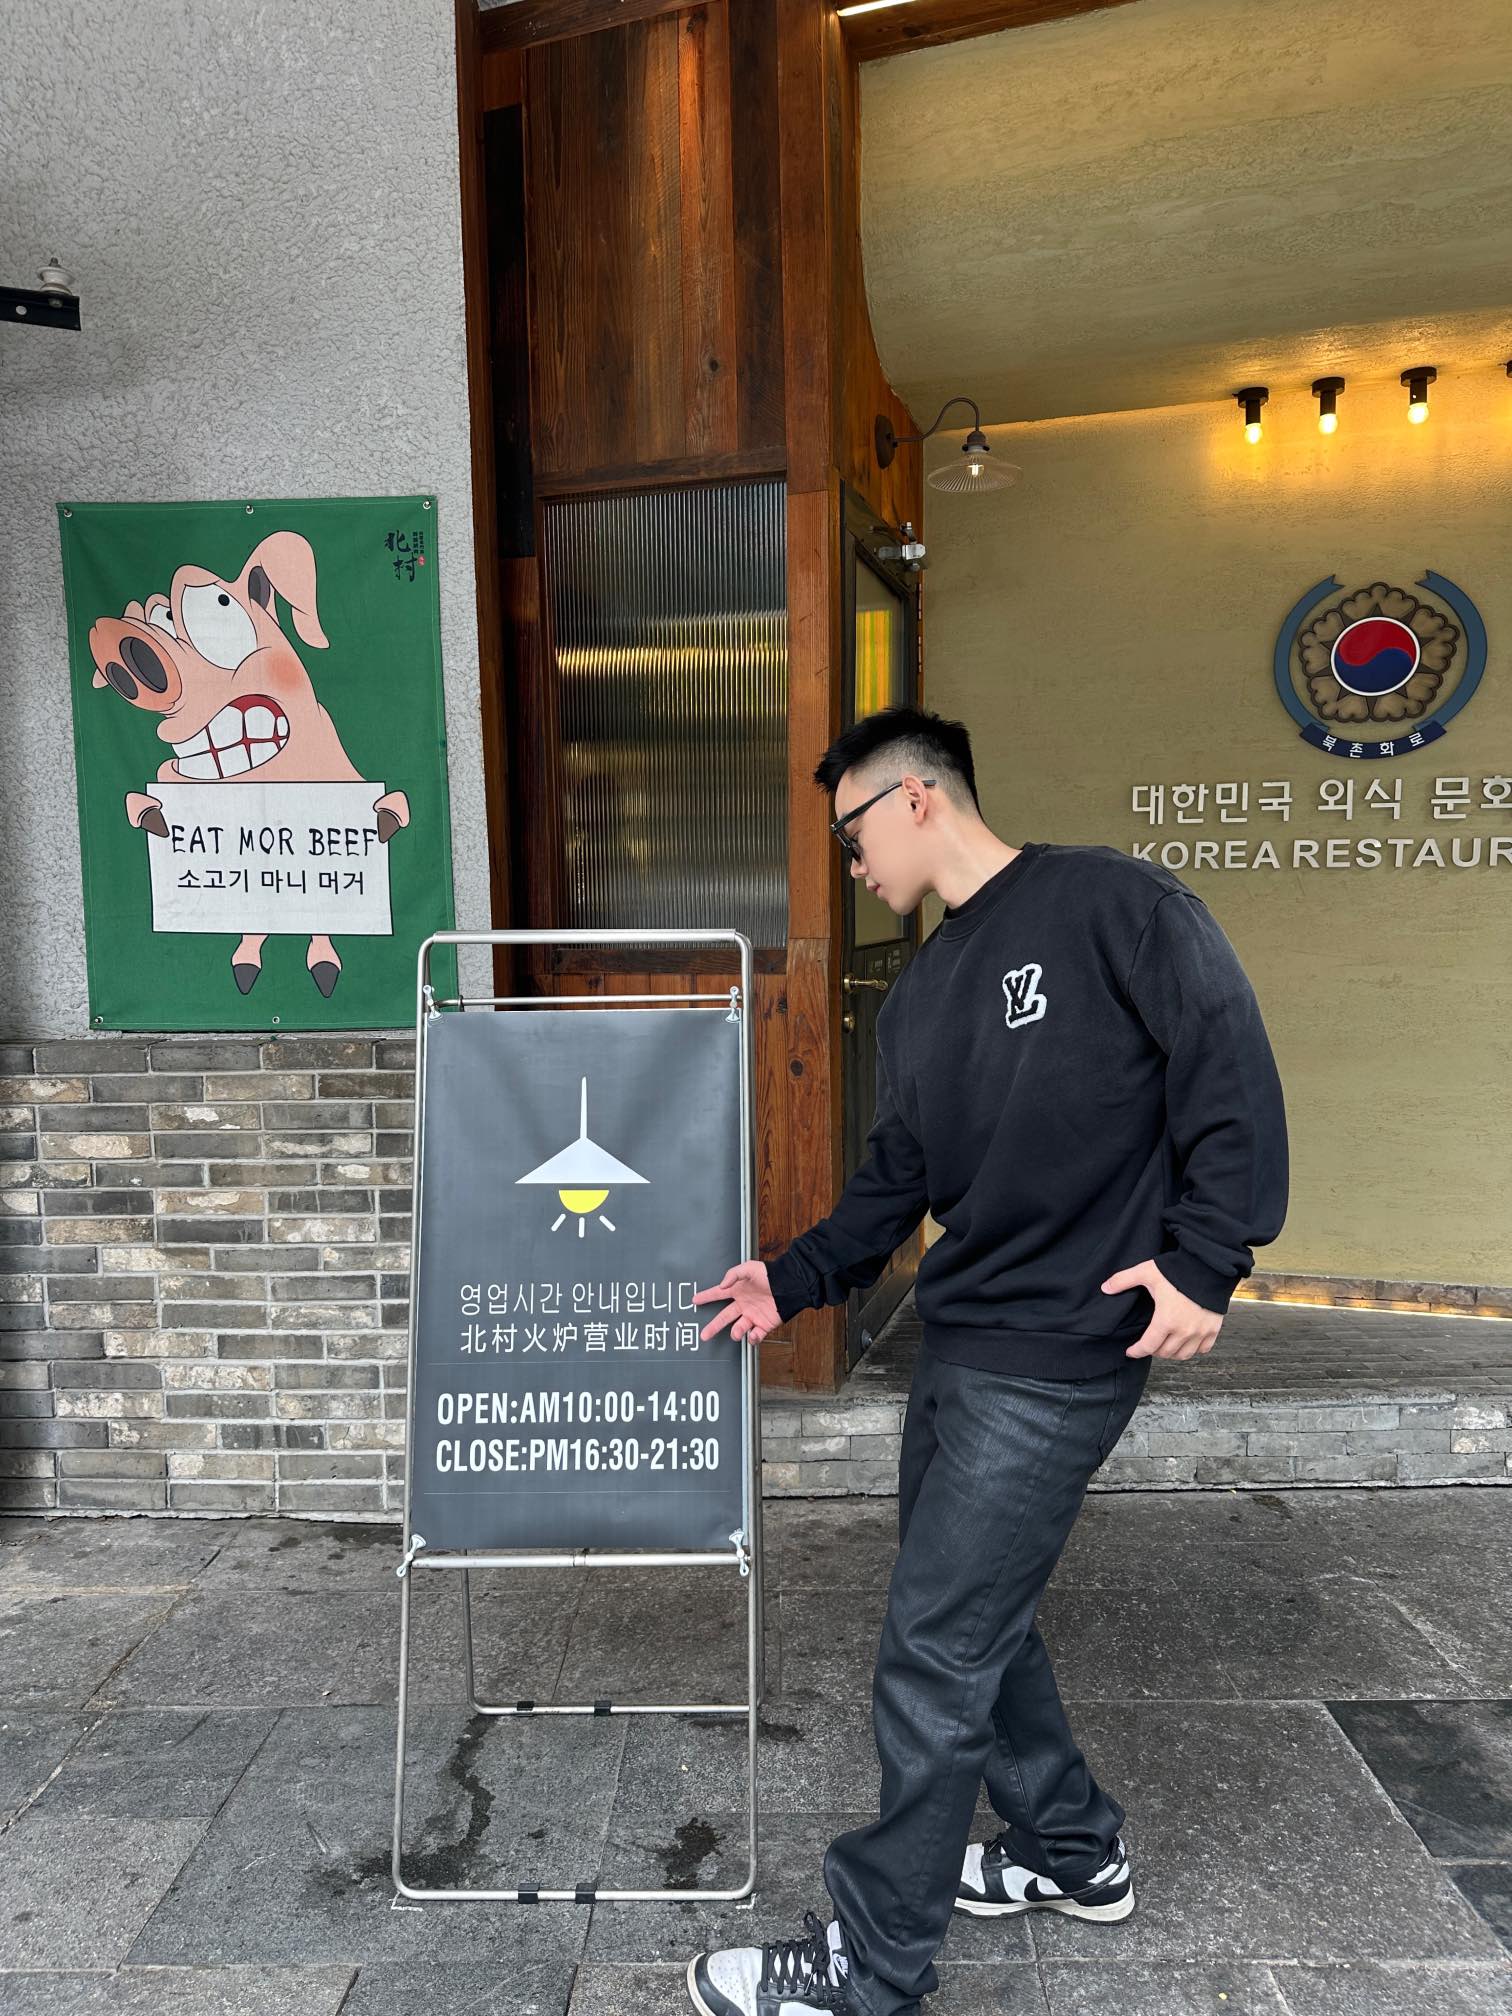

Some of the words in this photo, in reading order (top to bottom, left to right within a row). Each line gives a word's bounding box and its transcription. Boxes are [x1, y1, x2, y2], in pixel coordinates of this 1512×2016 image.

[1132, 781, 1293, 825] 대한민국
[1317, 778, 1402, 821] 외식
[171, 824, 224, 853] EAT
[239, 826, 295, 855] MOR
[308, 828, 378, 856] BEEF
[1132, 840, 1281, 870] KOREA
[1292, 837, 1512, 870] RESTAUR
[177, 869, 249, 893] 소고기
[261, 869, 306, 894] 마니
[318, 870, 364, 895] 머거
[460, 1282, 563, 1316] 영업시간
[572, 1281, 698, 1314] 안내입니다
[459, 1321, 700, 1354] 北村火炉营业时间
[437, 1390, 720, 1425] OPEN:AM10:00-14:00
[435, 1437, 720, 1472] CLOSE:PM16:30-21:30
